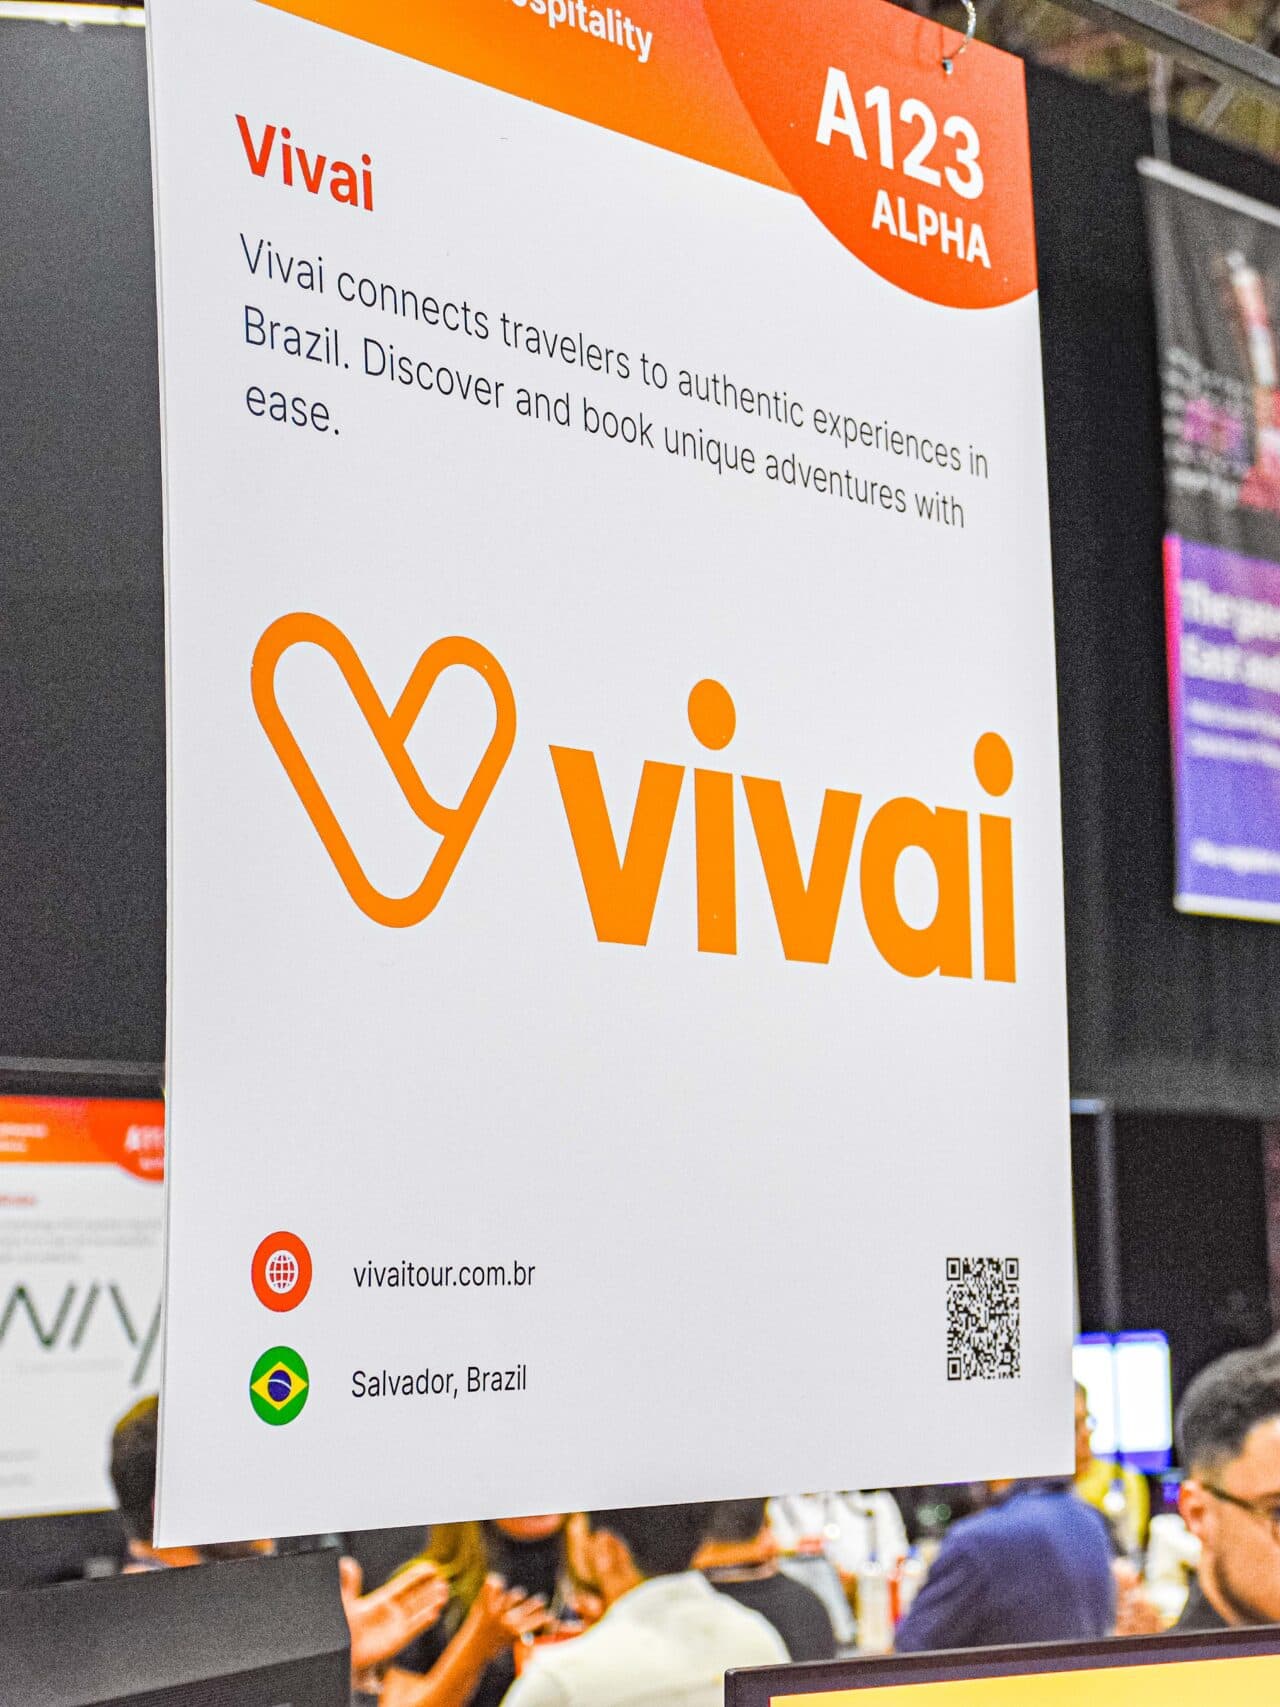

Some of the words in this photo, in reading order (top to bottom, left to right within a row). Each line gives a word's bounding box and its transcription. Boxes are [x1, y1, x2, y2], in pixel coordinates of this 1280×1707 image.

[512, 0, 653, 63] spitality
[235, 114, 374, 212] Vivai
[815, 66, 983, 200] A123
[872, 189, 990, 269] ALPHA
[240, 233, 323, 293] Vivai
[337, 271, 489, 339] connects
[500, 312, 631, 379] travelers
[640, 352, 668, 389] to
[678, 369, 804, 427] authentic
[813, 408, 961, 471] experiences
[969, 445, 989, 479] in
[244, 305, 349, 369] Brazil.
[363, 337, 504, 409] Discover
[516, 388, 571, 427] and
[583, 397, 654, 449] book
[664, 426, 755, 475] unique
[765, 453, 907, 513] adventures
[915, 491, 965, 528] with
[246, 385, 340, 435] ease.
[548, 678, 1017, 984] vivai
[353, 1260, 536, 1288] vivaitour.com.br
[351, 1368, 458, 1400] Salvador,
[467, 1364, 527, 1393] Brazil
